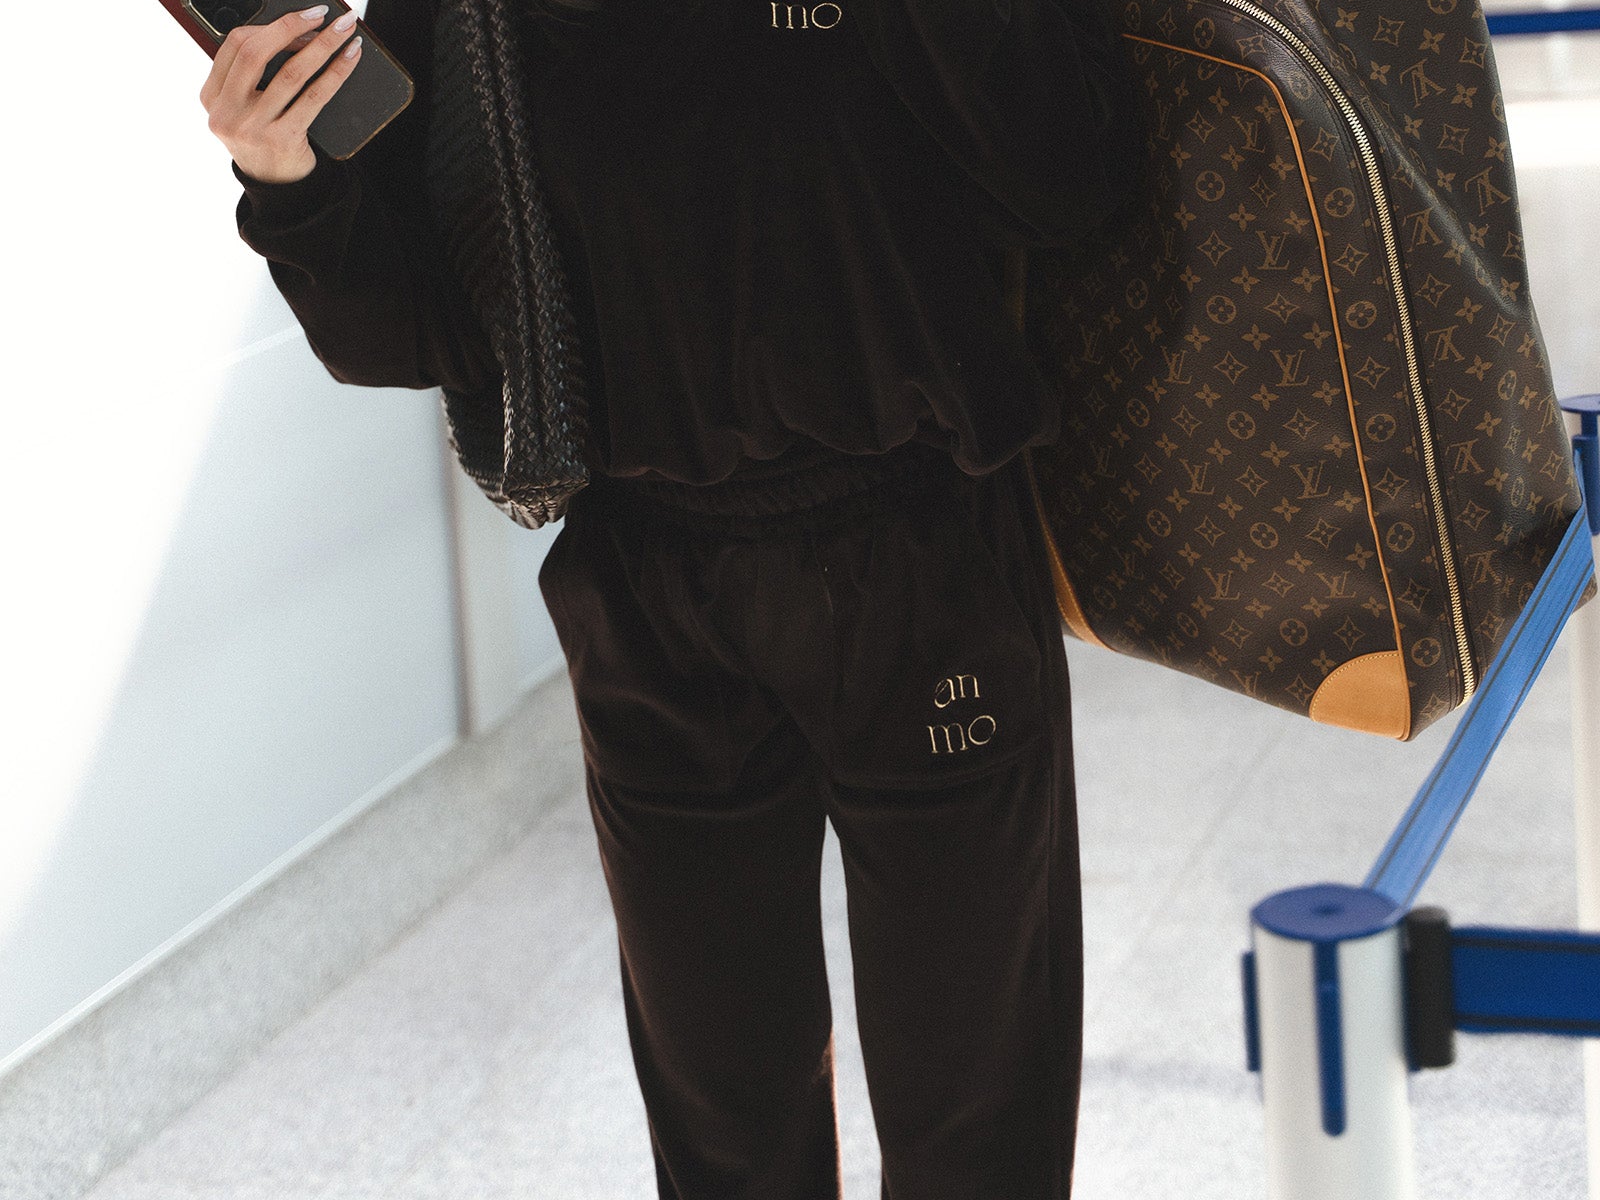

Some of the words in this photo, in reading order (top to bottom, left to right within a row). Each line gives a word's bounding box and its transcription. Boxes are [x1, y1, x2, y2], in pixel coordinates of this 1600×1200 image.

[770, 2, 842, 29] mo
[1256, 230, 1290, 270] LV
[1160, 345, 1192, 384] LV
[1271, 349, 1309, 387] LV
[1179, 458, 1215, 495] LV
[1290, 463, 1331, 499] LV
[1203, 567, 1240, 600] LV
[1317, 571, 1356, 598] LV
[934, 674, 980, 709] an
[926, 715, 996, 754] mo
